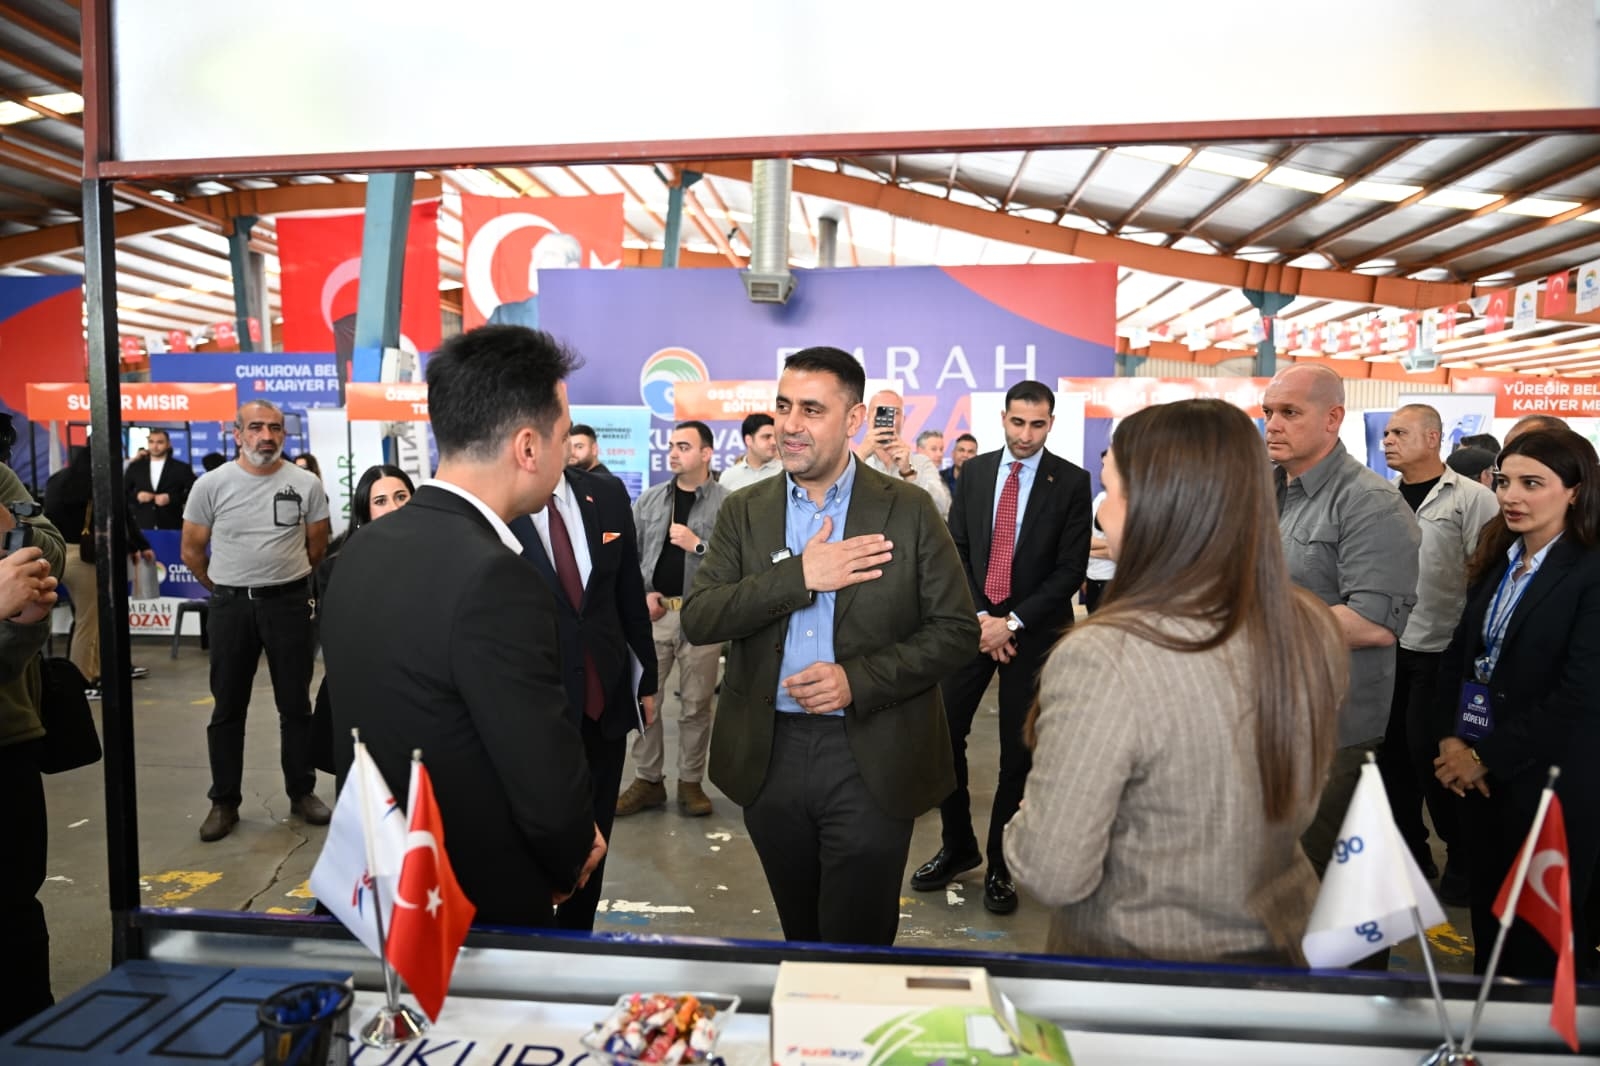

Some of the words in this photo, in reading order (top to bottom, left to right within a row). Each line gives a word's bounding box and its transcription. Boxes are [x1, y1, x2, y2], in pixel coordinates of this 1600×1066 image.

[235, 364, 311, 379] ÇUKUROVA
[776, 344, 1037, 390] RAH
[1503, 381, 1570, 395] YÜREĞİR
[67, 395, 132, 410] SUR
[137, 395, 189, 410] MISIR
[1513, 397, 1579, 411] KARİYER
